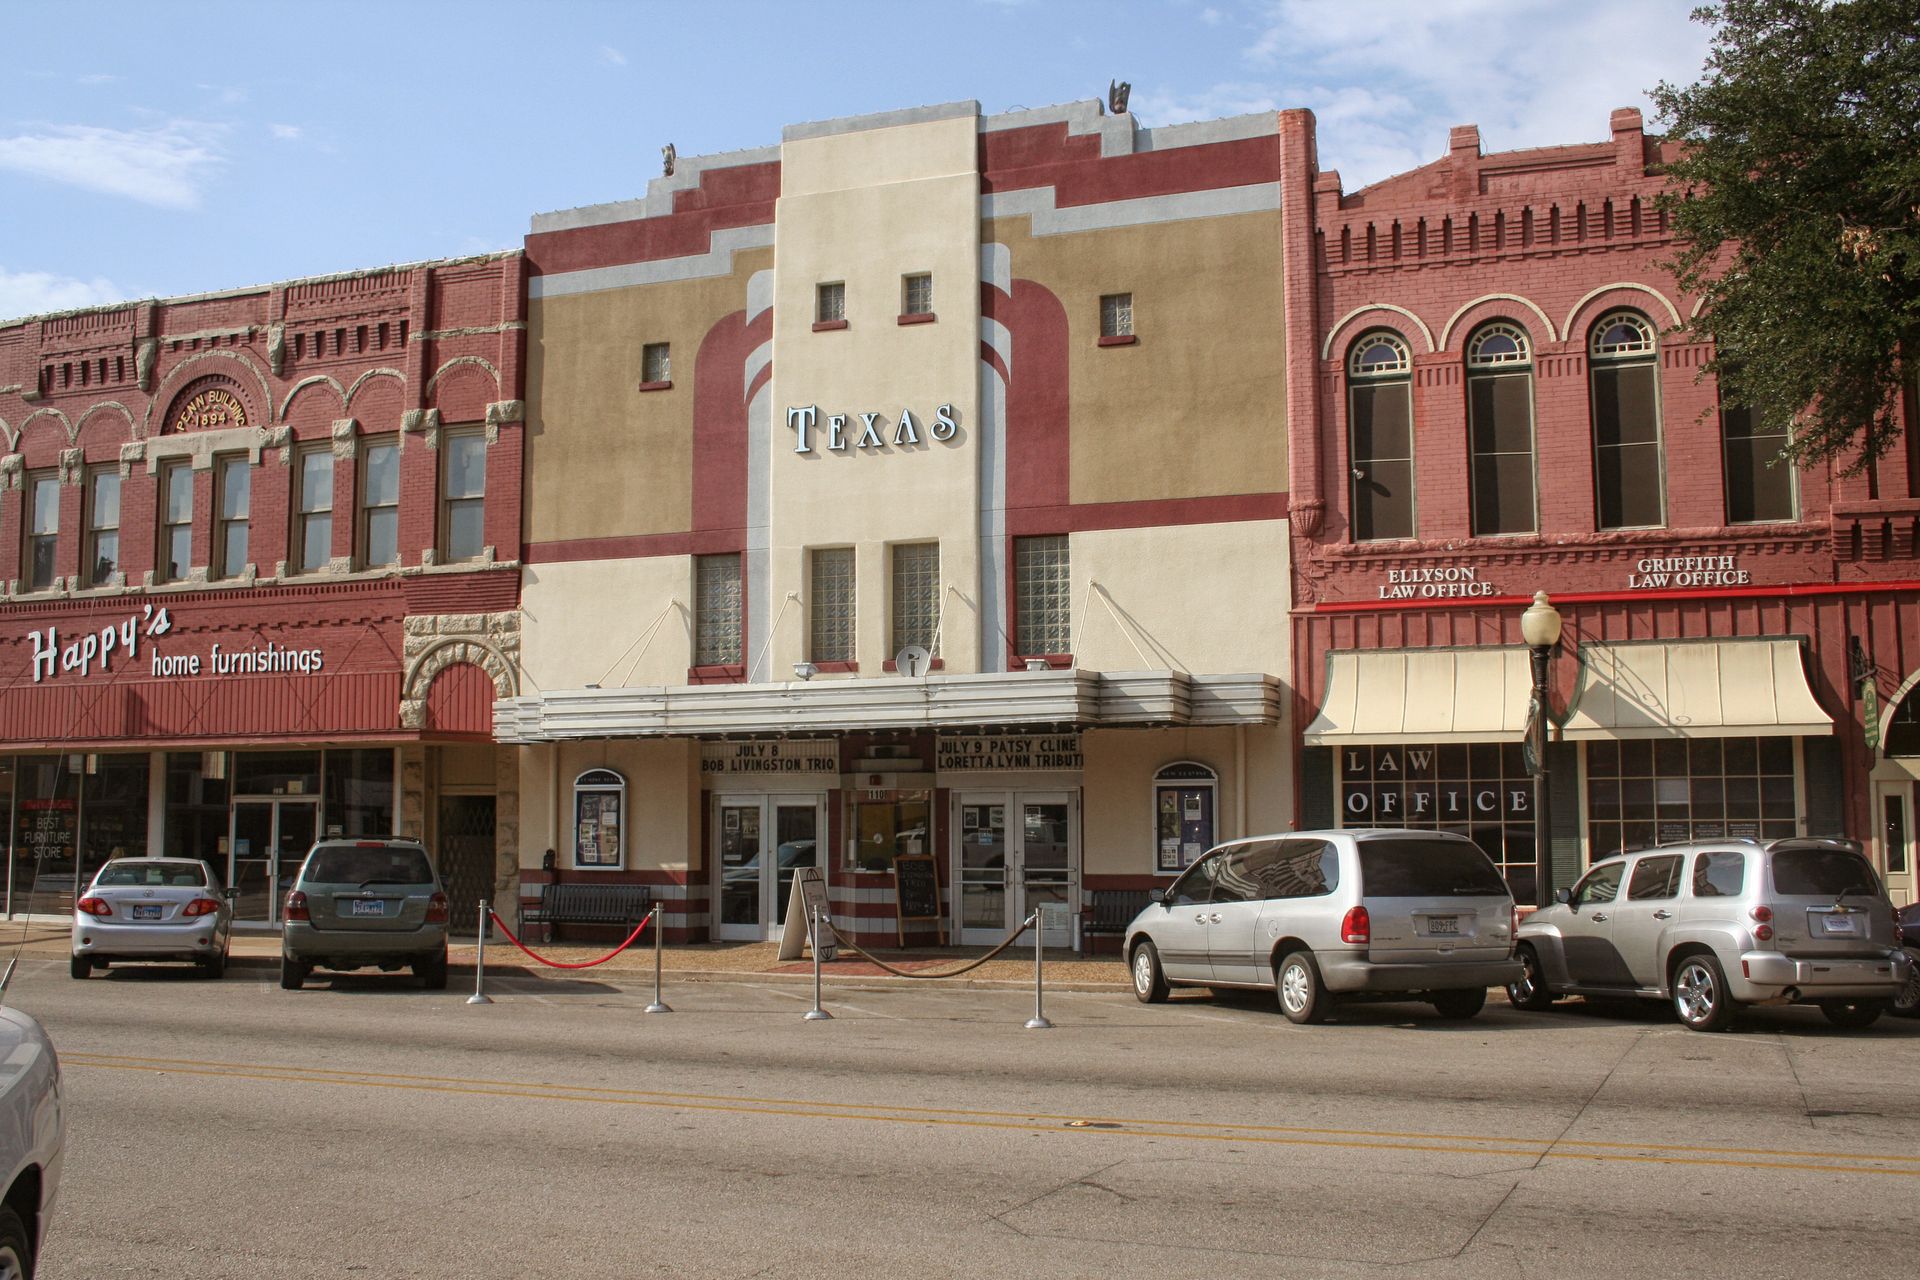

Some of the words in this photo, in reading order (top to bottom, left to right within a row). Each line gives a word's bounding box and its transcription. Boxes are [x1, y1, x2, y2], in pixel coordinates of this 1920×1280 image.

[176, 394, 205, 431] PENN
[208, 390, 245, 427] BUILDING
[196, 412, 226, 427] 1894
[786, 403, 957, 453] TEXAS
[1637, 555, 1735, 573] GRIFFITH
[1388, 567, 1475, 583] ELLYSON
[1628, 573, 1670, 588] LAW
[1675, 570, 1750, 586] OFFICE
[1379, 585, 1417, 599] LAW
[1421, 582, 1493, 597] OFFICE
[28, 604, 171, 682] Happy's
[152, 647, 200, 676] home
[211, 642, 323, 674] furnishings
[736, 745, 765, 757] JULY
[771, 745, 779, 756] 8
[938, 741, 969, 753] JULY
[974, 741, 982, 753] 9
[990, 740, 1031, 752] PATSY
[1039, 739, 1076, 751] CLINE
[702, 760, 724, 771] BOB
[731, 759, 800, 771] LIVINGSTON
[807, 759, 834, 771] TRIO
[938, 756, 993, 768] LORETTA
[998, 754, 1030, 767] LYNN
[1348, 750, 1433, 772] LAW
[1347, 791, 1528, 813] OFFICE
[36, 817, 60, 830] BEST
[24, 832, 71, 844] FURNITURE
[33, 846, 62, 859] STORE
